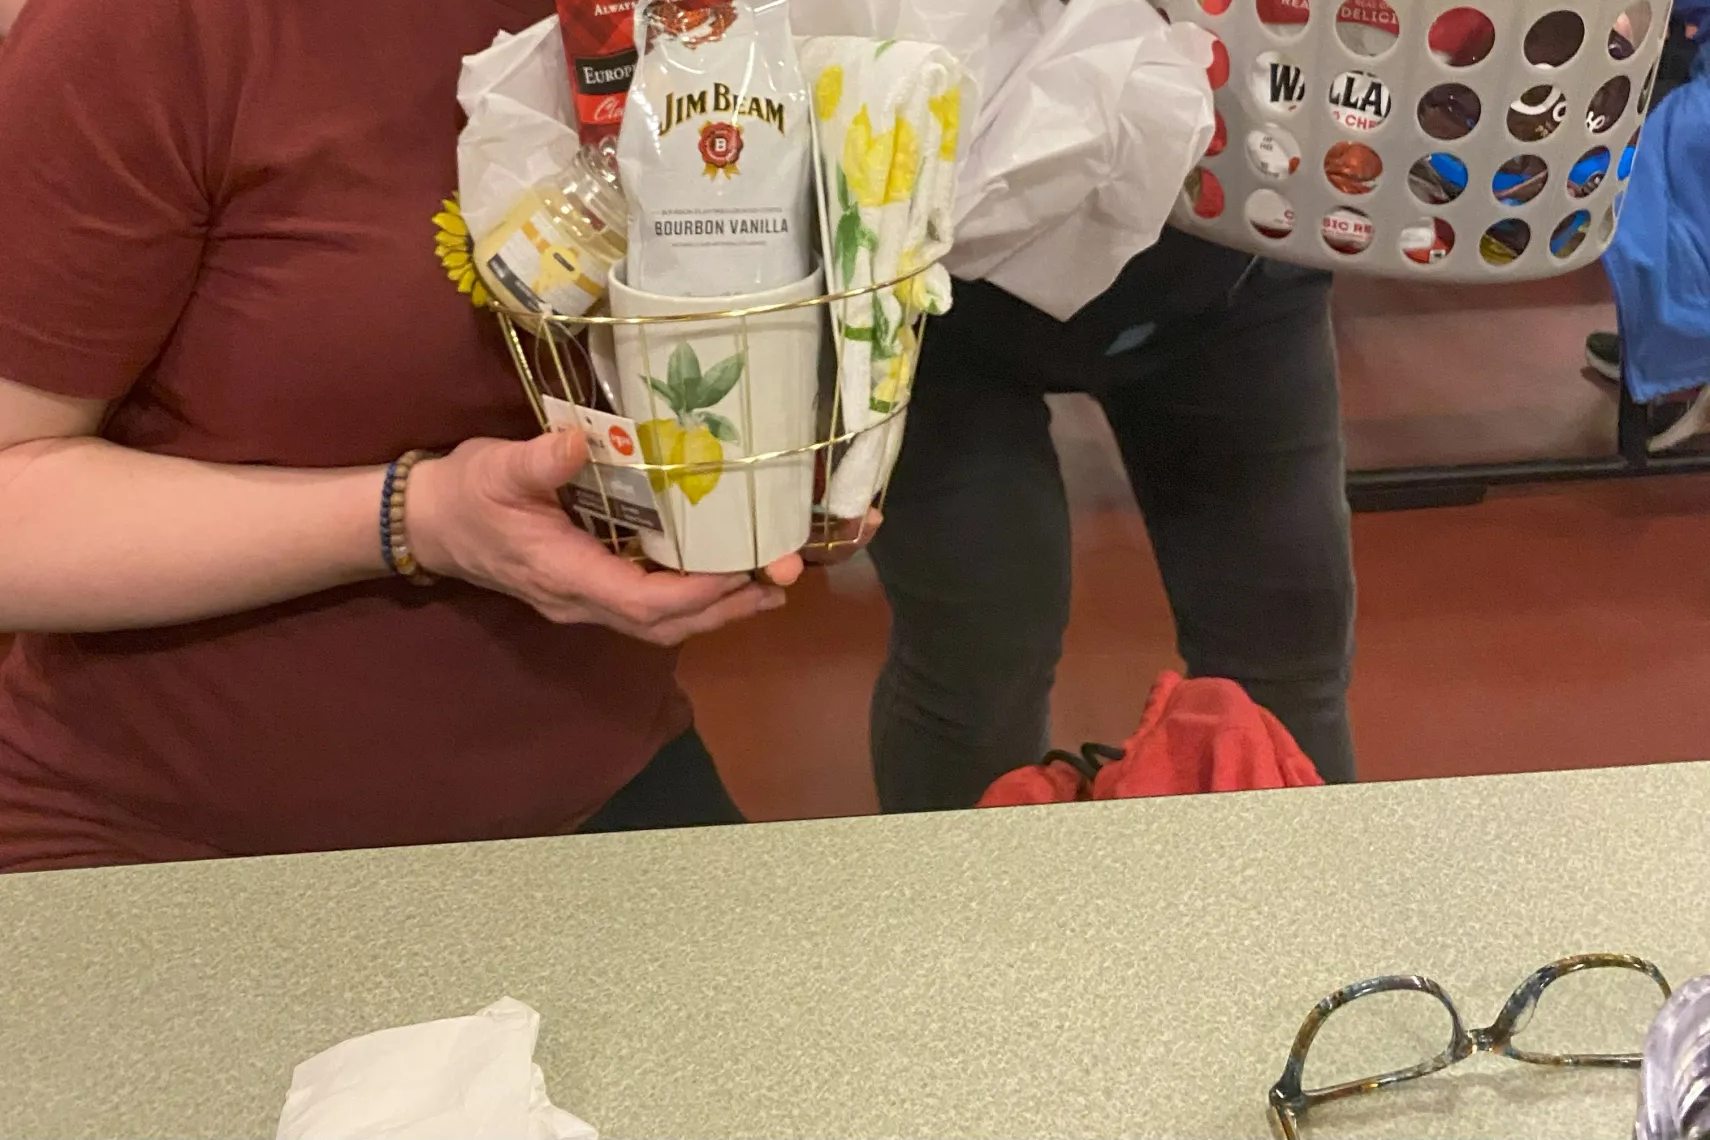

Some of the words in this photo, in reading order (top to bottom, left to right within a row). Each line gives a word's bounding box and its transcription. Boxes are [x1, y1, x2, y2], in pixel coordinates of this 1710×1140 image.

[1341, 7, 1398, 24] DELICI
[658, 91, 708, 136] JIM
[713, 82, 786, 136] BEAM
[655, 219, 725, 236] BOURBON
[729, 218, 789, 234] VANILLA
[1353, 221, 1373, 233] RE
